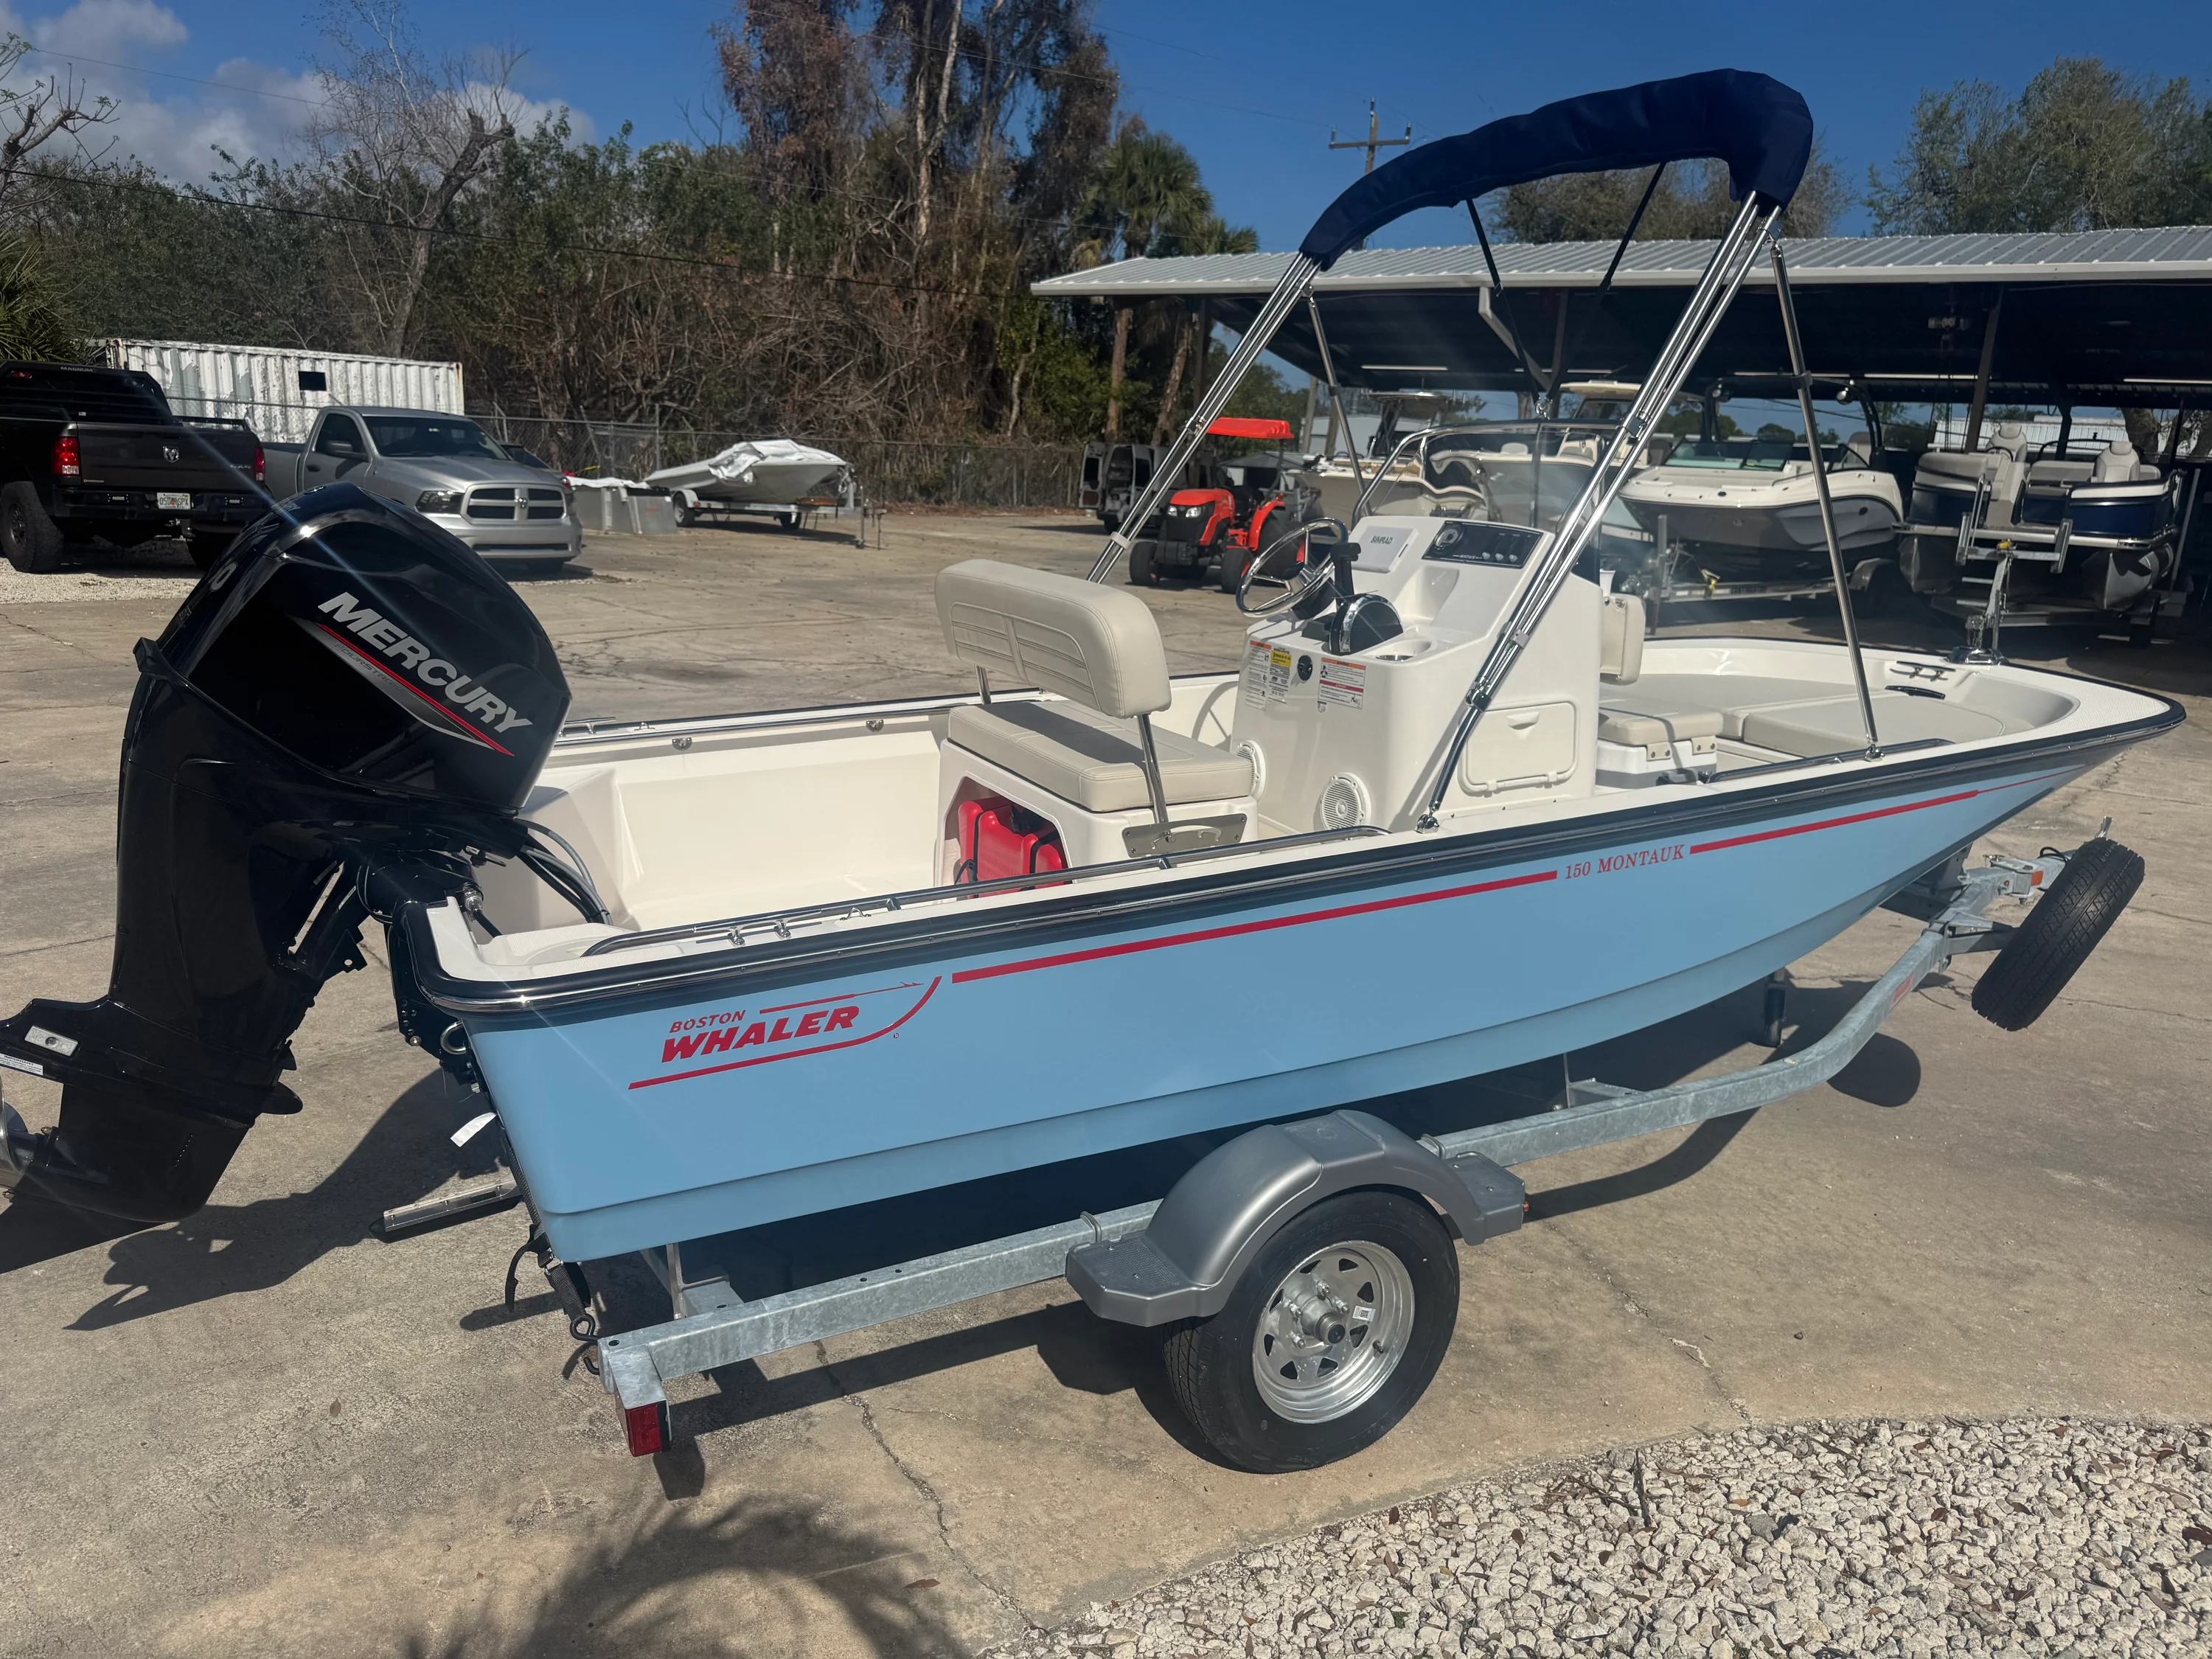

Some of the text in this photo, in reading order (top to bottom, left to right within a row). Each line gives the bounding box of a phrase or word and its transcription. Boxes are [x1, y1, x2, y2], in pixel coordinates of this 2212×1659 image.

[1370, 535, 1394, 545] SIMRAD
[318, 592, 533, 733] MERCURY
[1565, 844, 1686, 879] 150 MONTAUK
[661, 1005, 860, 1063] WHALER
[669, 1009, 746, 1033] BOSTON
